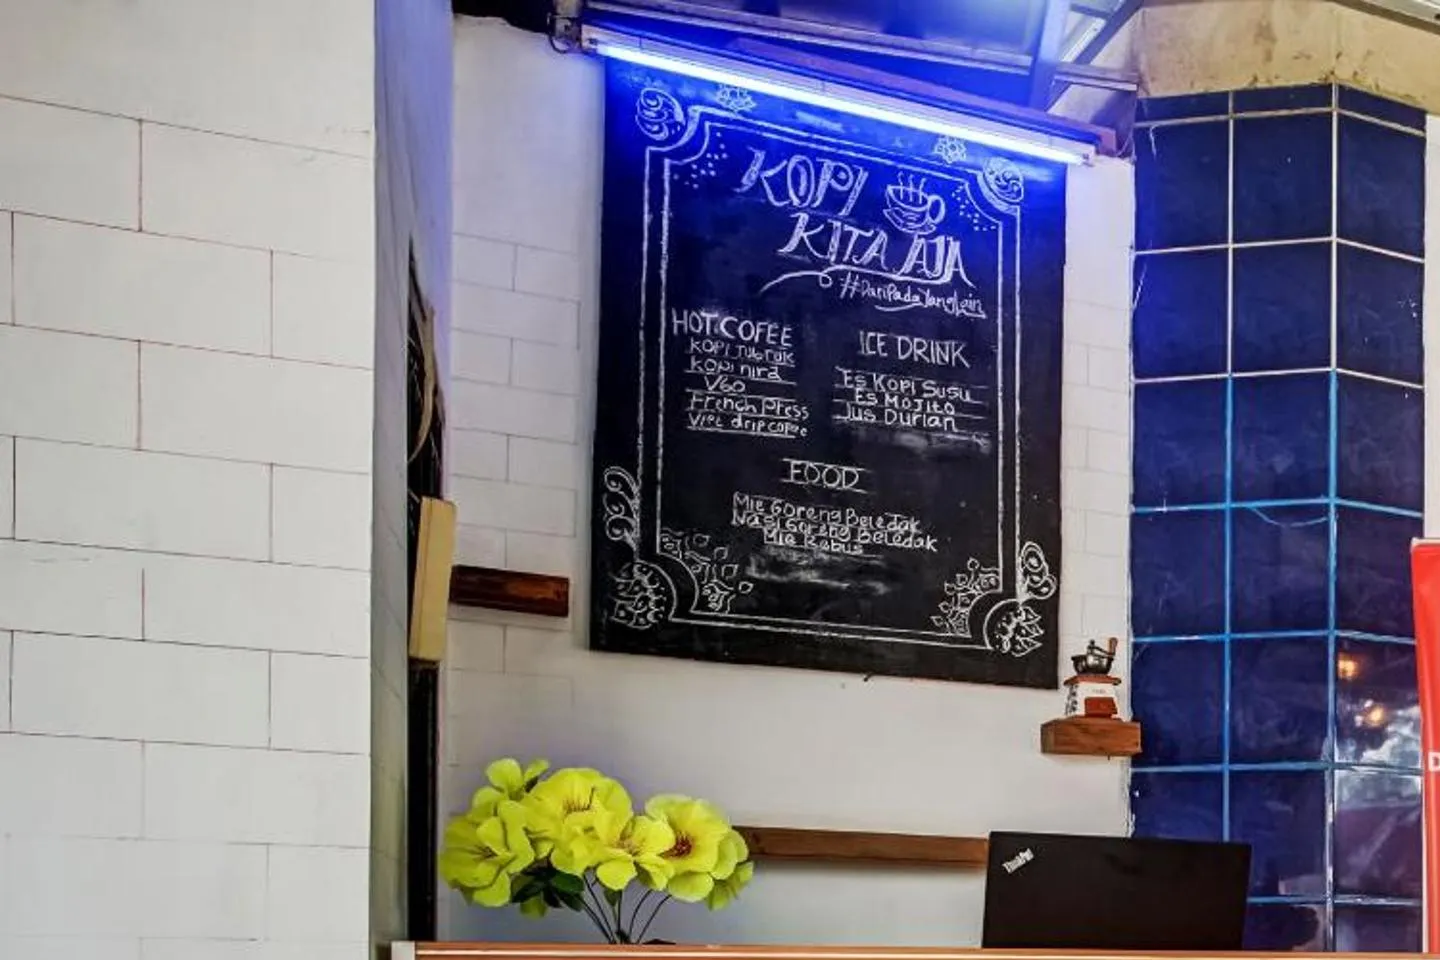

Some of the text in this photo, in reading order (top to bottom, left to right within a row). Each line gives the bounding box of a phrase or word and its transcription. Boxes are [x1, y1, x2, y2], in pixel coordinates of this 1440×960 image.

[733, 146, 868, 215] KOPI
[777, 213, 975, 288] KITA AJA
[672, 308, 793, 347] HOT COFEE
[858, 331, 971, 368] ICE DRINK
[843, 369, 867, 388] Es
[922, 380, 971, 402] Susu
[855, 388, 878, 406] Es
[844, 401, 958, 432] Jus Durian
[790, 461, 859, 489] FOOD
